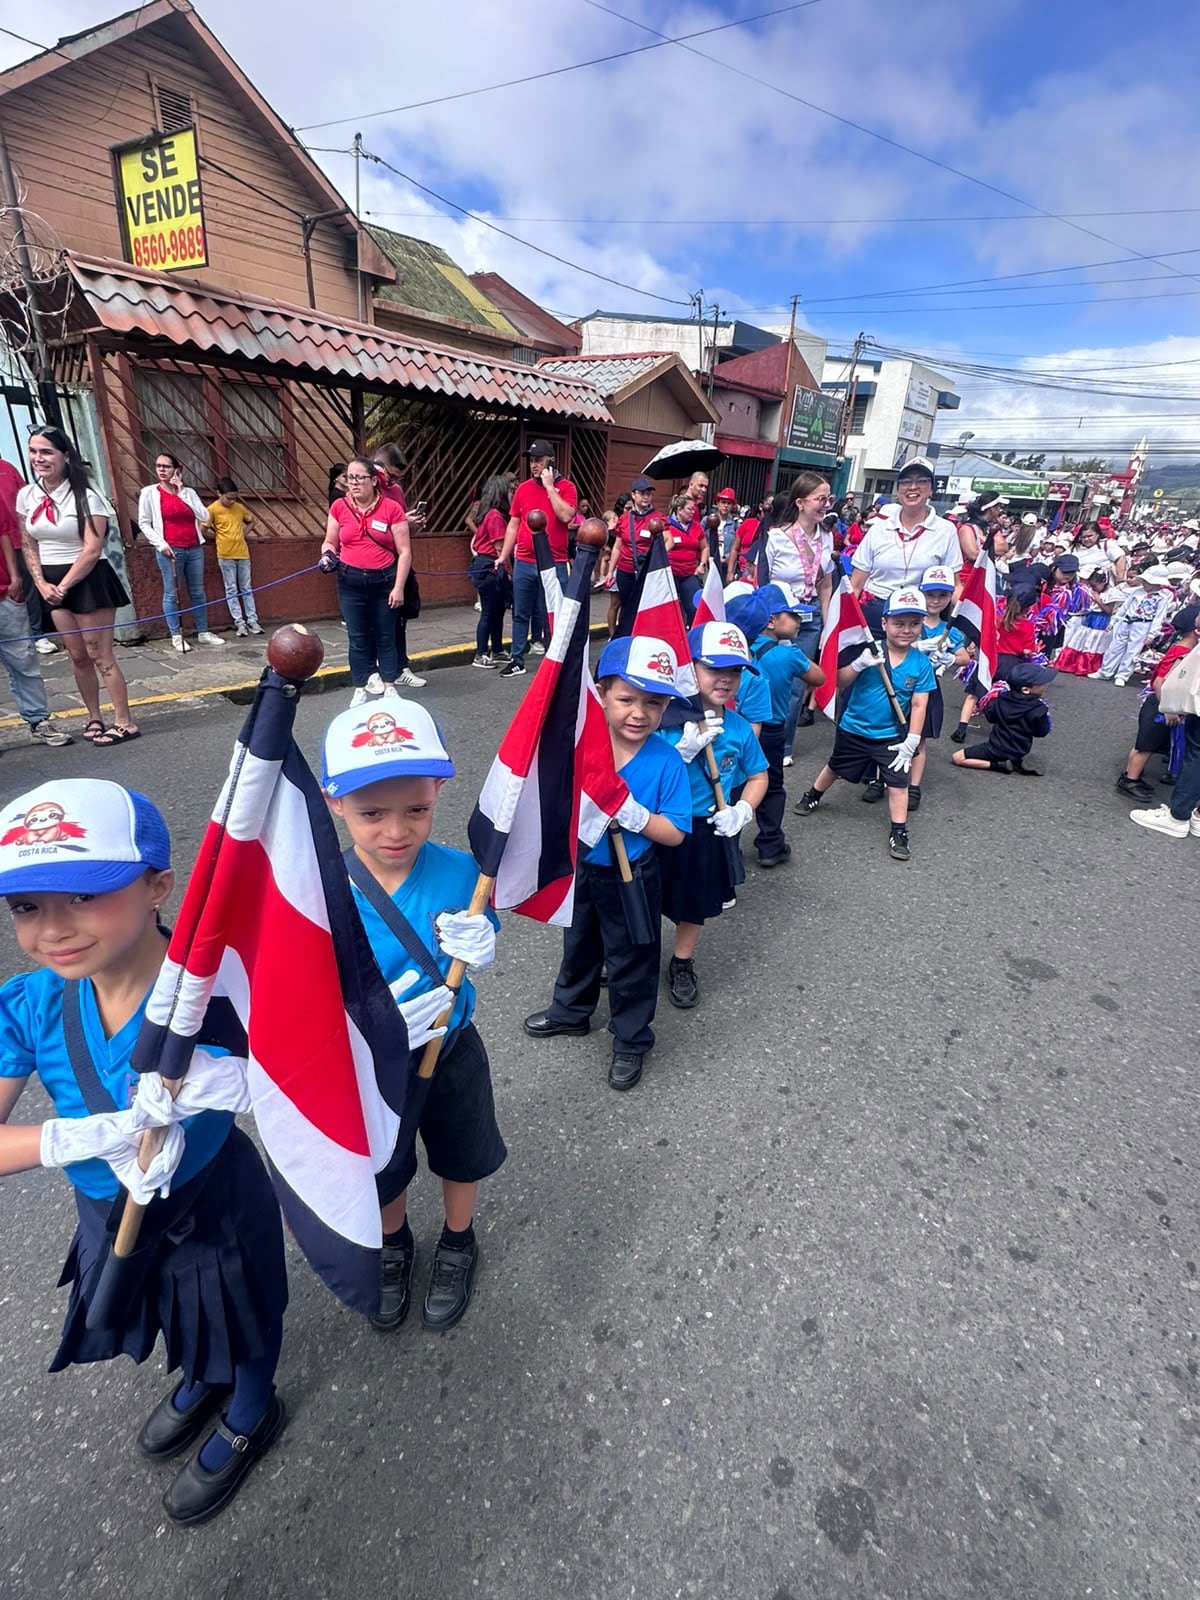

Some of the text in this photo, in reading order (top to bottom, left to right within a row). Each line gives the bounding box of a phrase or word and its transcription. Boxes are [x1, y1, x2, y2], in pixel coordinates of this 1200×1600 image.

[141, 141, 178, 183] SE
[127, 179, 201, 227] VENDE
[134, 225, 204, 267] 8560-9889
[18, 846, 57, 857] COSTA RICA
